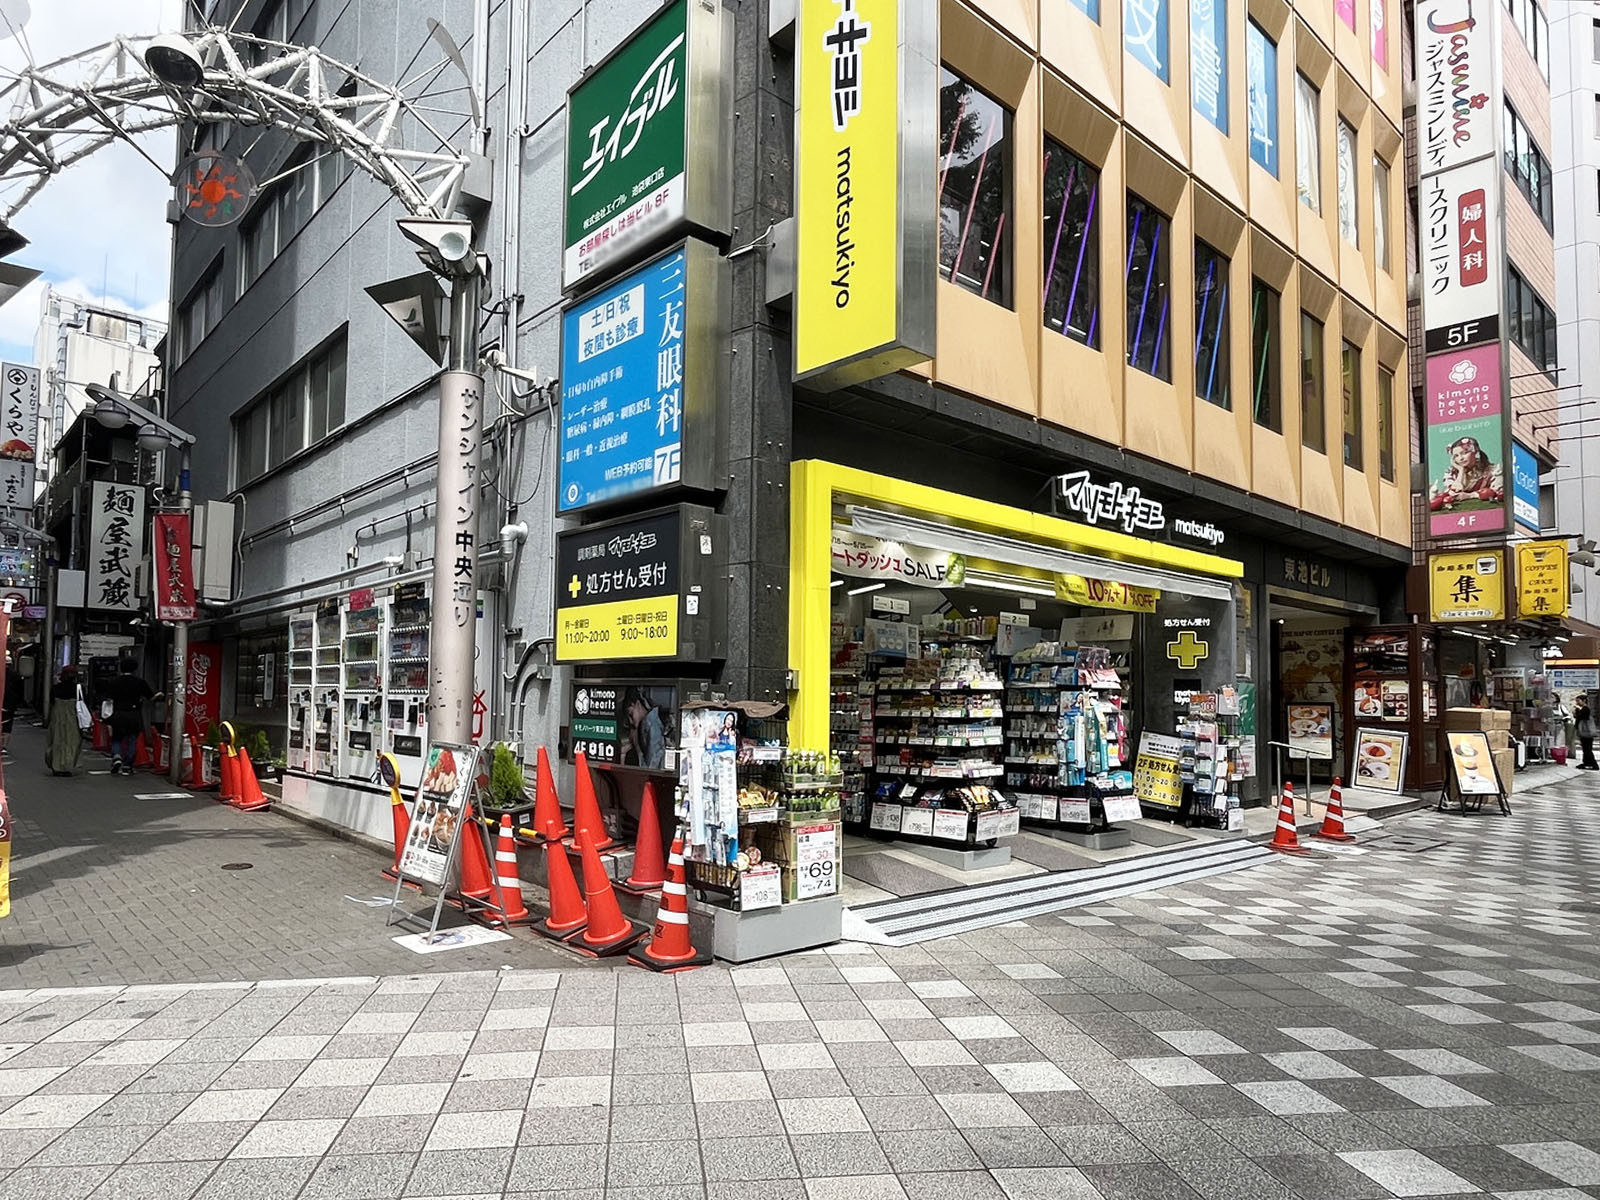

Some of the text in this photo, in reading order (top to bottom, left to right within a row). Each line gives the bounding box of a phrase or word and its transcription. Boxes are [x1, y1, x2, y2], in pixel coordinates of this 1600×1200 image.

[1426, 40, 1450, 295] ジャスミンレディースクリニック
[831, 146, 855, 308] matsukiyo
[1462, 203, 1483, 271] 婦人科
[592, 294, 631, 329] 土日祝
[584, 316, 639, 358] 夜間も診療
[656, 254, 684, 437] 三友眼科
[1447, 322, 1480, 346] 5F
[1438, 385, 1489, 400] kimono
[1438, 393, 1489, 408] hearts
[6, 387, 24, 436] くらや
[656, 449, 681, 482] 7F
[452, 388, 479, 628] サンシャイン中央通り
[1457, 515, 1476, 527] 4F
[98, 485, 136, 608] 麺屋武蔵
[1174, 518, 1225, 546] matsukiyo
[586, 561, 667, 595] 処方せん受付
[1284, 557, 1331, 588] 東池ビル
[1450, 575, 1483, 603] 集
[1532, 596, 1551, 611] 集
[1164, 618, 1210, 627] 処方せん受付
[590, 688, 616, 698] kimono
[590, 699, 616, 709] hearts
[809, 860, 833, 878] 69
[816, 879, 831, 889] 74
